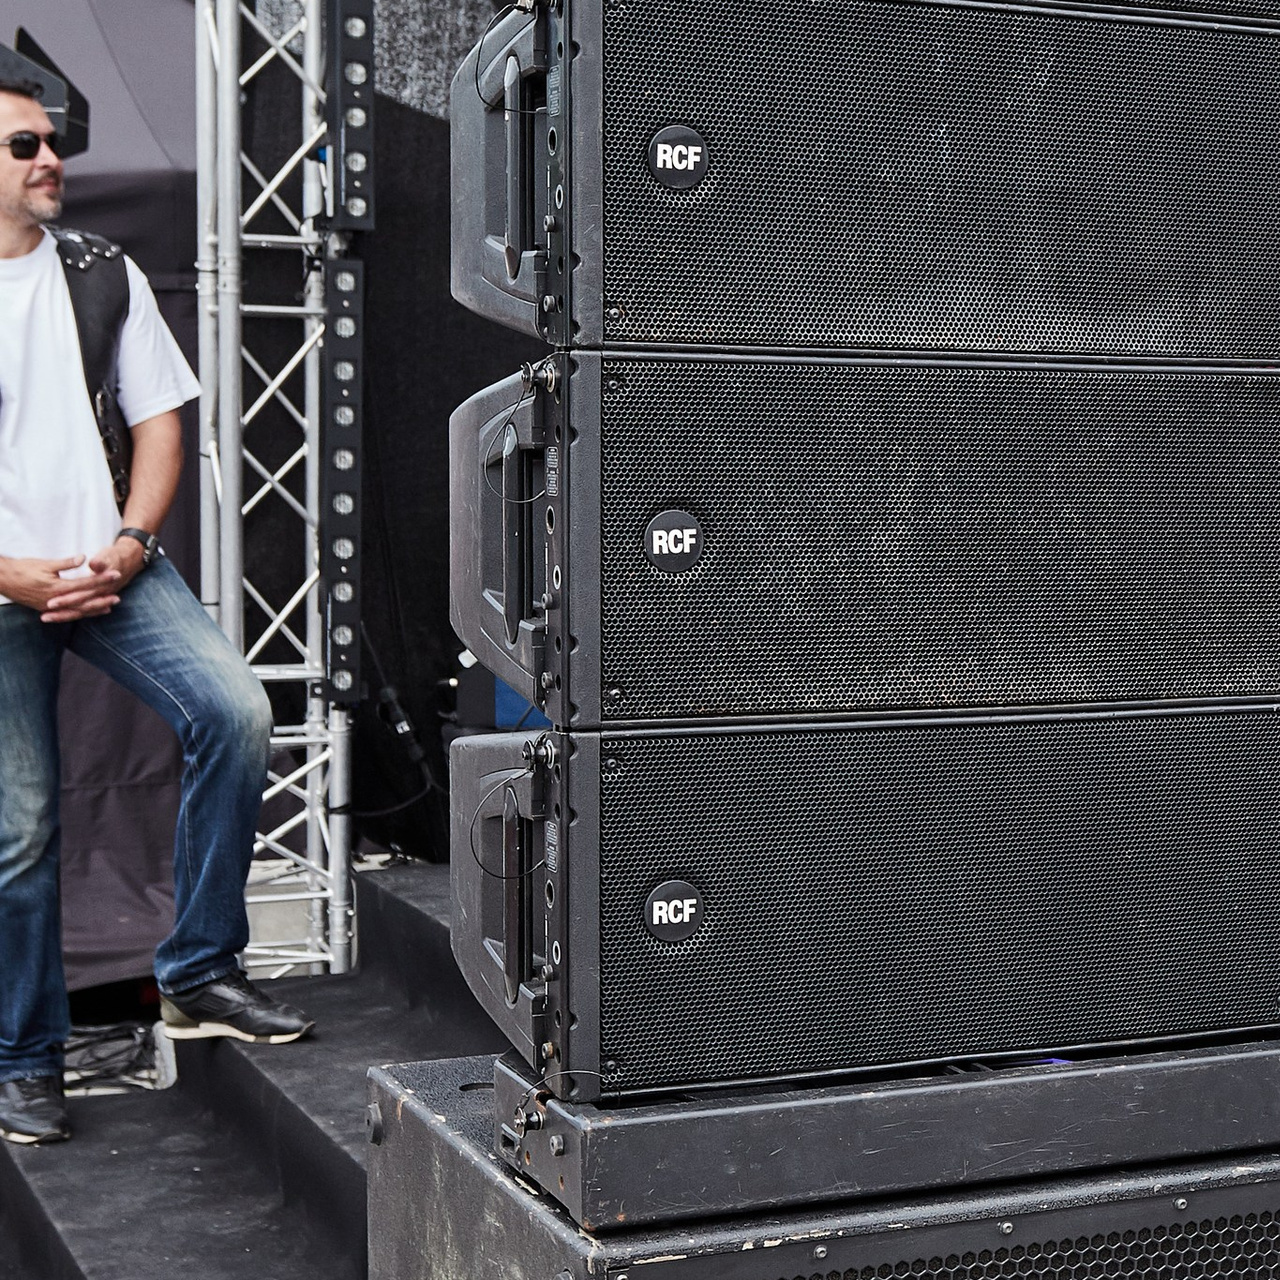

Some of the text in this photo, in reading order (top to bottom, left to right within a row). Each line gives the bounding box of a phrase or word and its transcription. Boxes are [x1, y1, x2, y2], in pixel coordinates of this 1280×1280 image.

[656, 143, 702, 170] RCF
[652, 528, 697, 555] RCF
[653, 899, 697, 925] RCF
